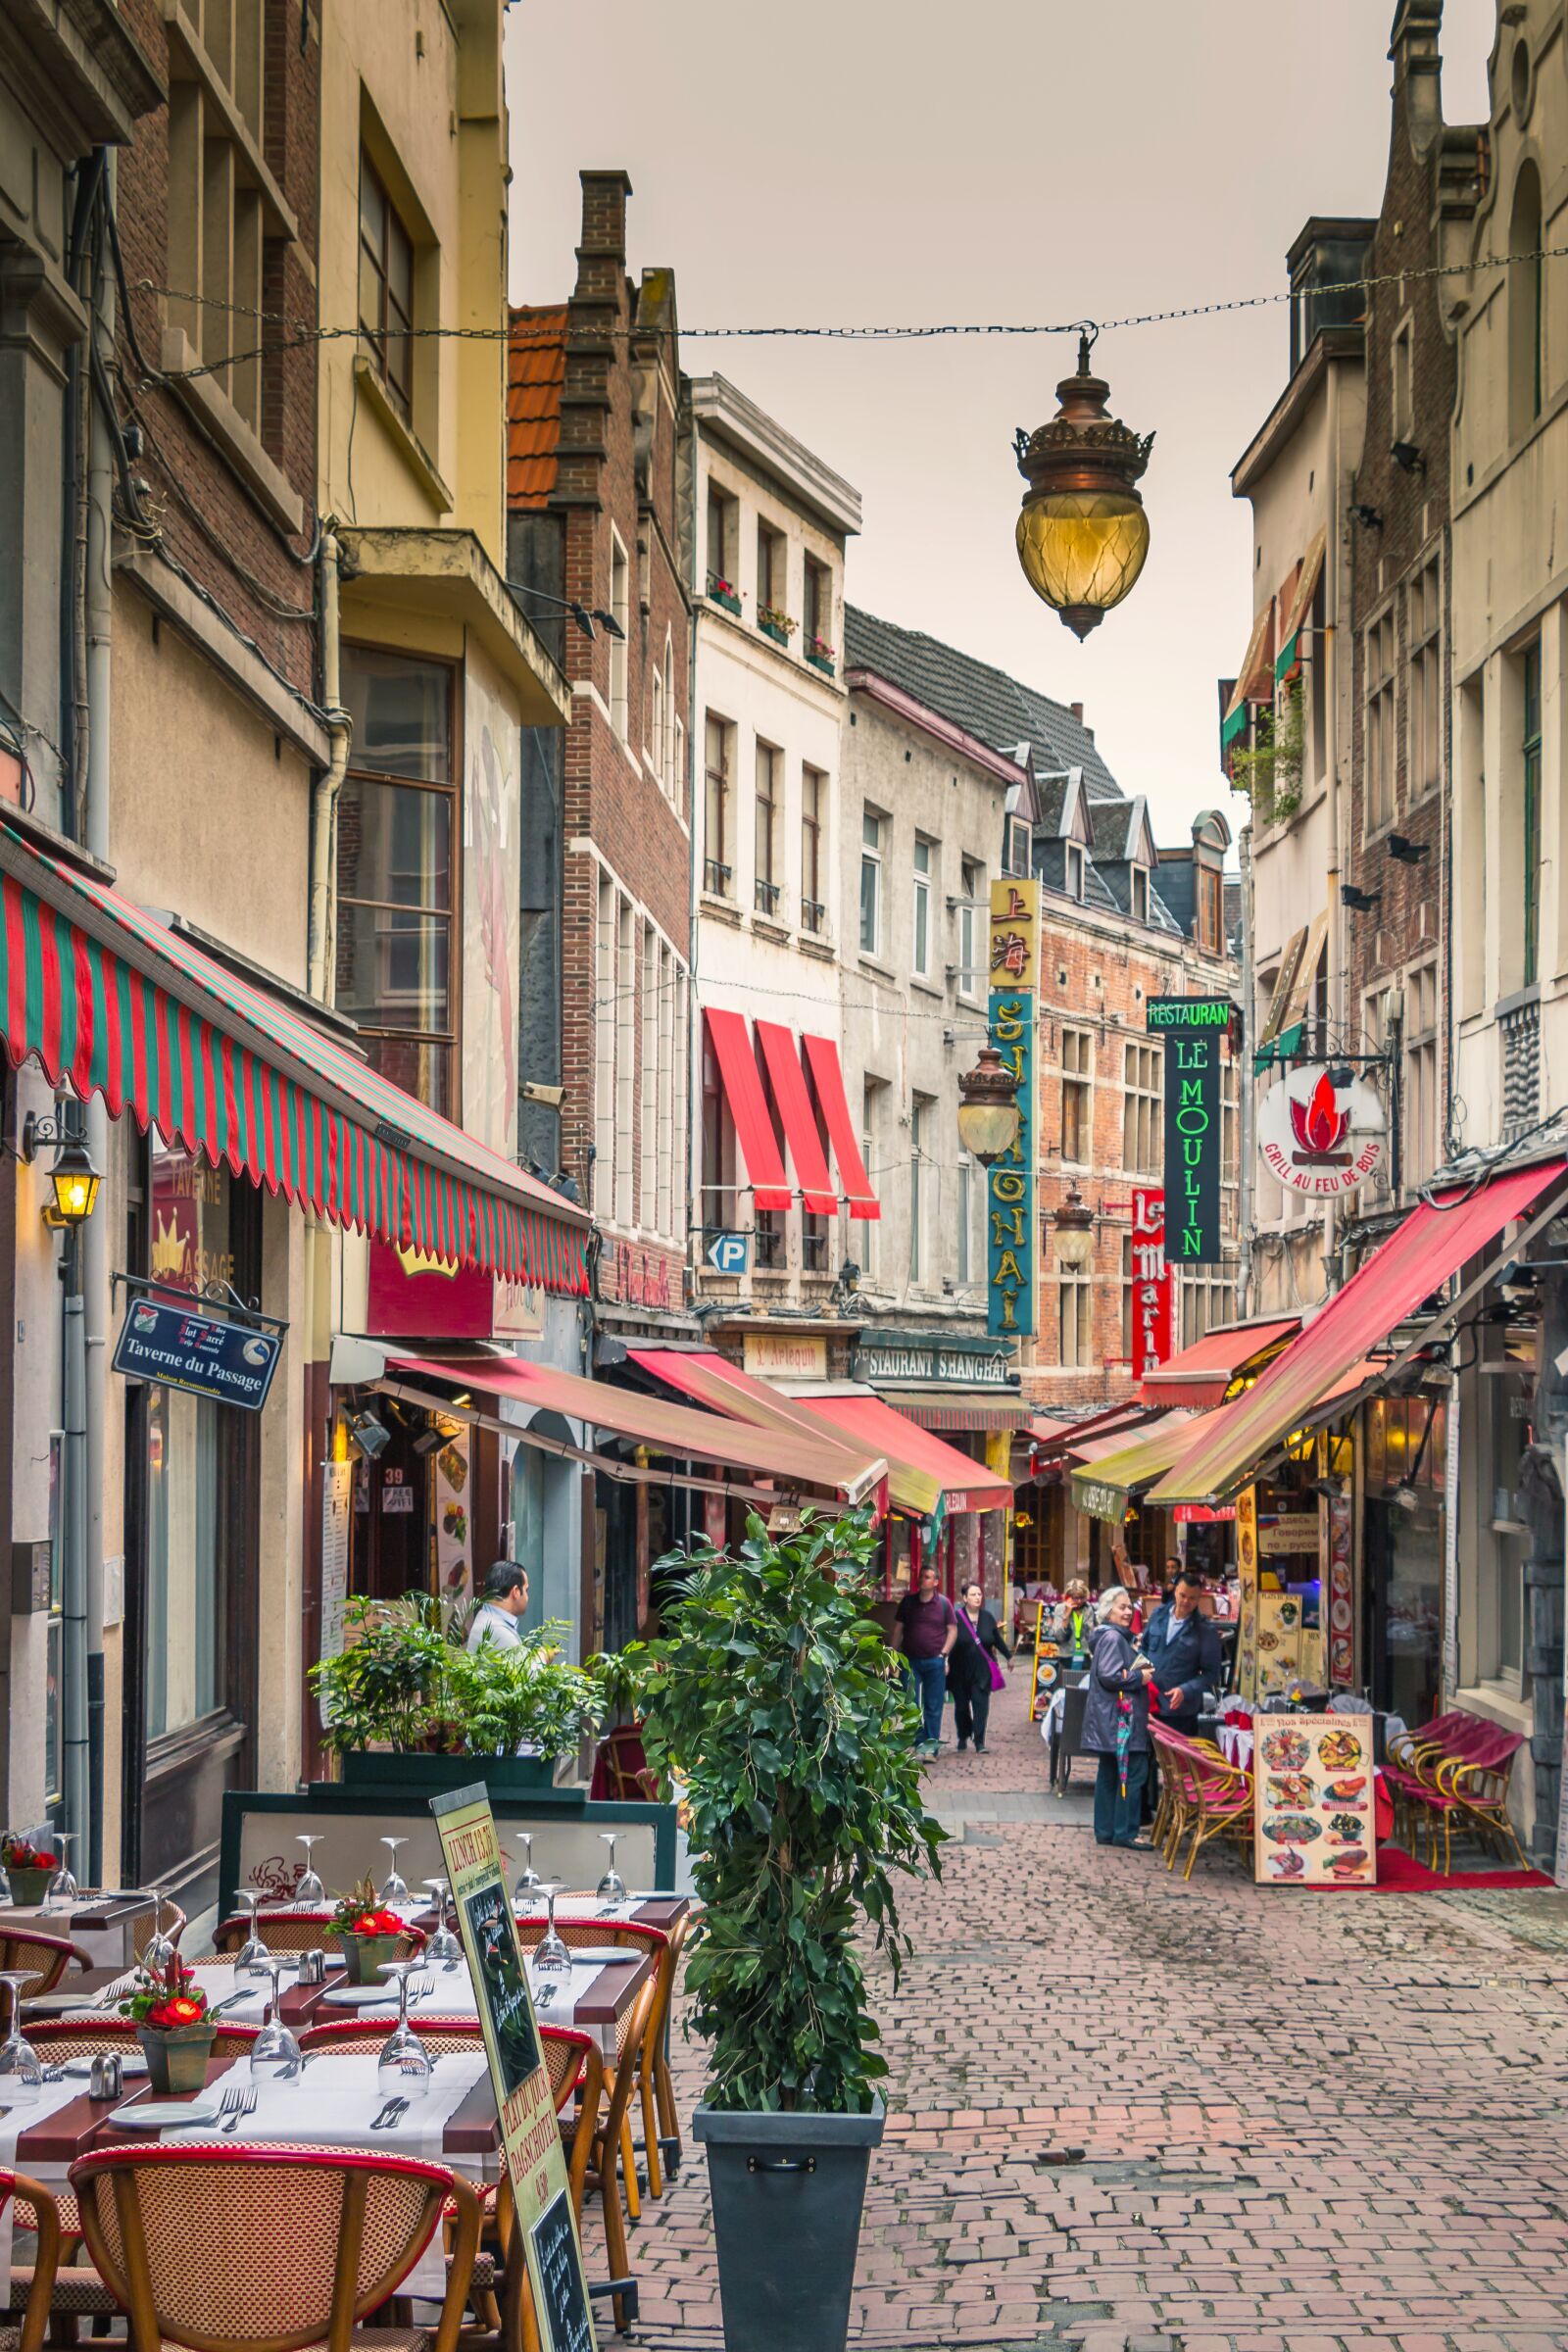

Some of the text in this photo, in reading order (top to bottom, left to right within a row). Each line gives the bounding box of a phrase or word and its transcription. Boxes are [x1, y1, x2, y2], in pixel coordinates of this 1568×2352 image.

[991, 888, 1031, 978] 上海
[1176, 1042, 1209, 1255] LE MOULIN
[1264, 1143, 1381, 1193] GRILL AU FEU DE BOIS
[722, 1242, 745, 1269] P
[127, 1338, 263, 1393] Taverne du Passage
[938, 1352, 1005, 1383] SHANGHAI
[385, 1468, 403, 1485] 39
[448, 1832, 478, 1873] LUNCH
[502, 2093, 523, 2138] PLAT
[518, 2081, 532, 2121] DU
[510, 2109, 558, 2186] DAGSCHOTEL
